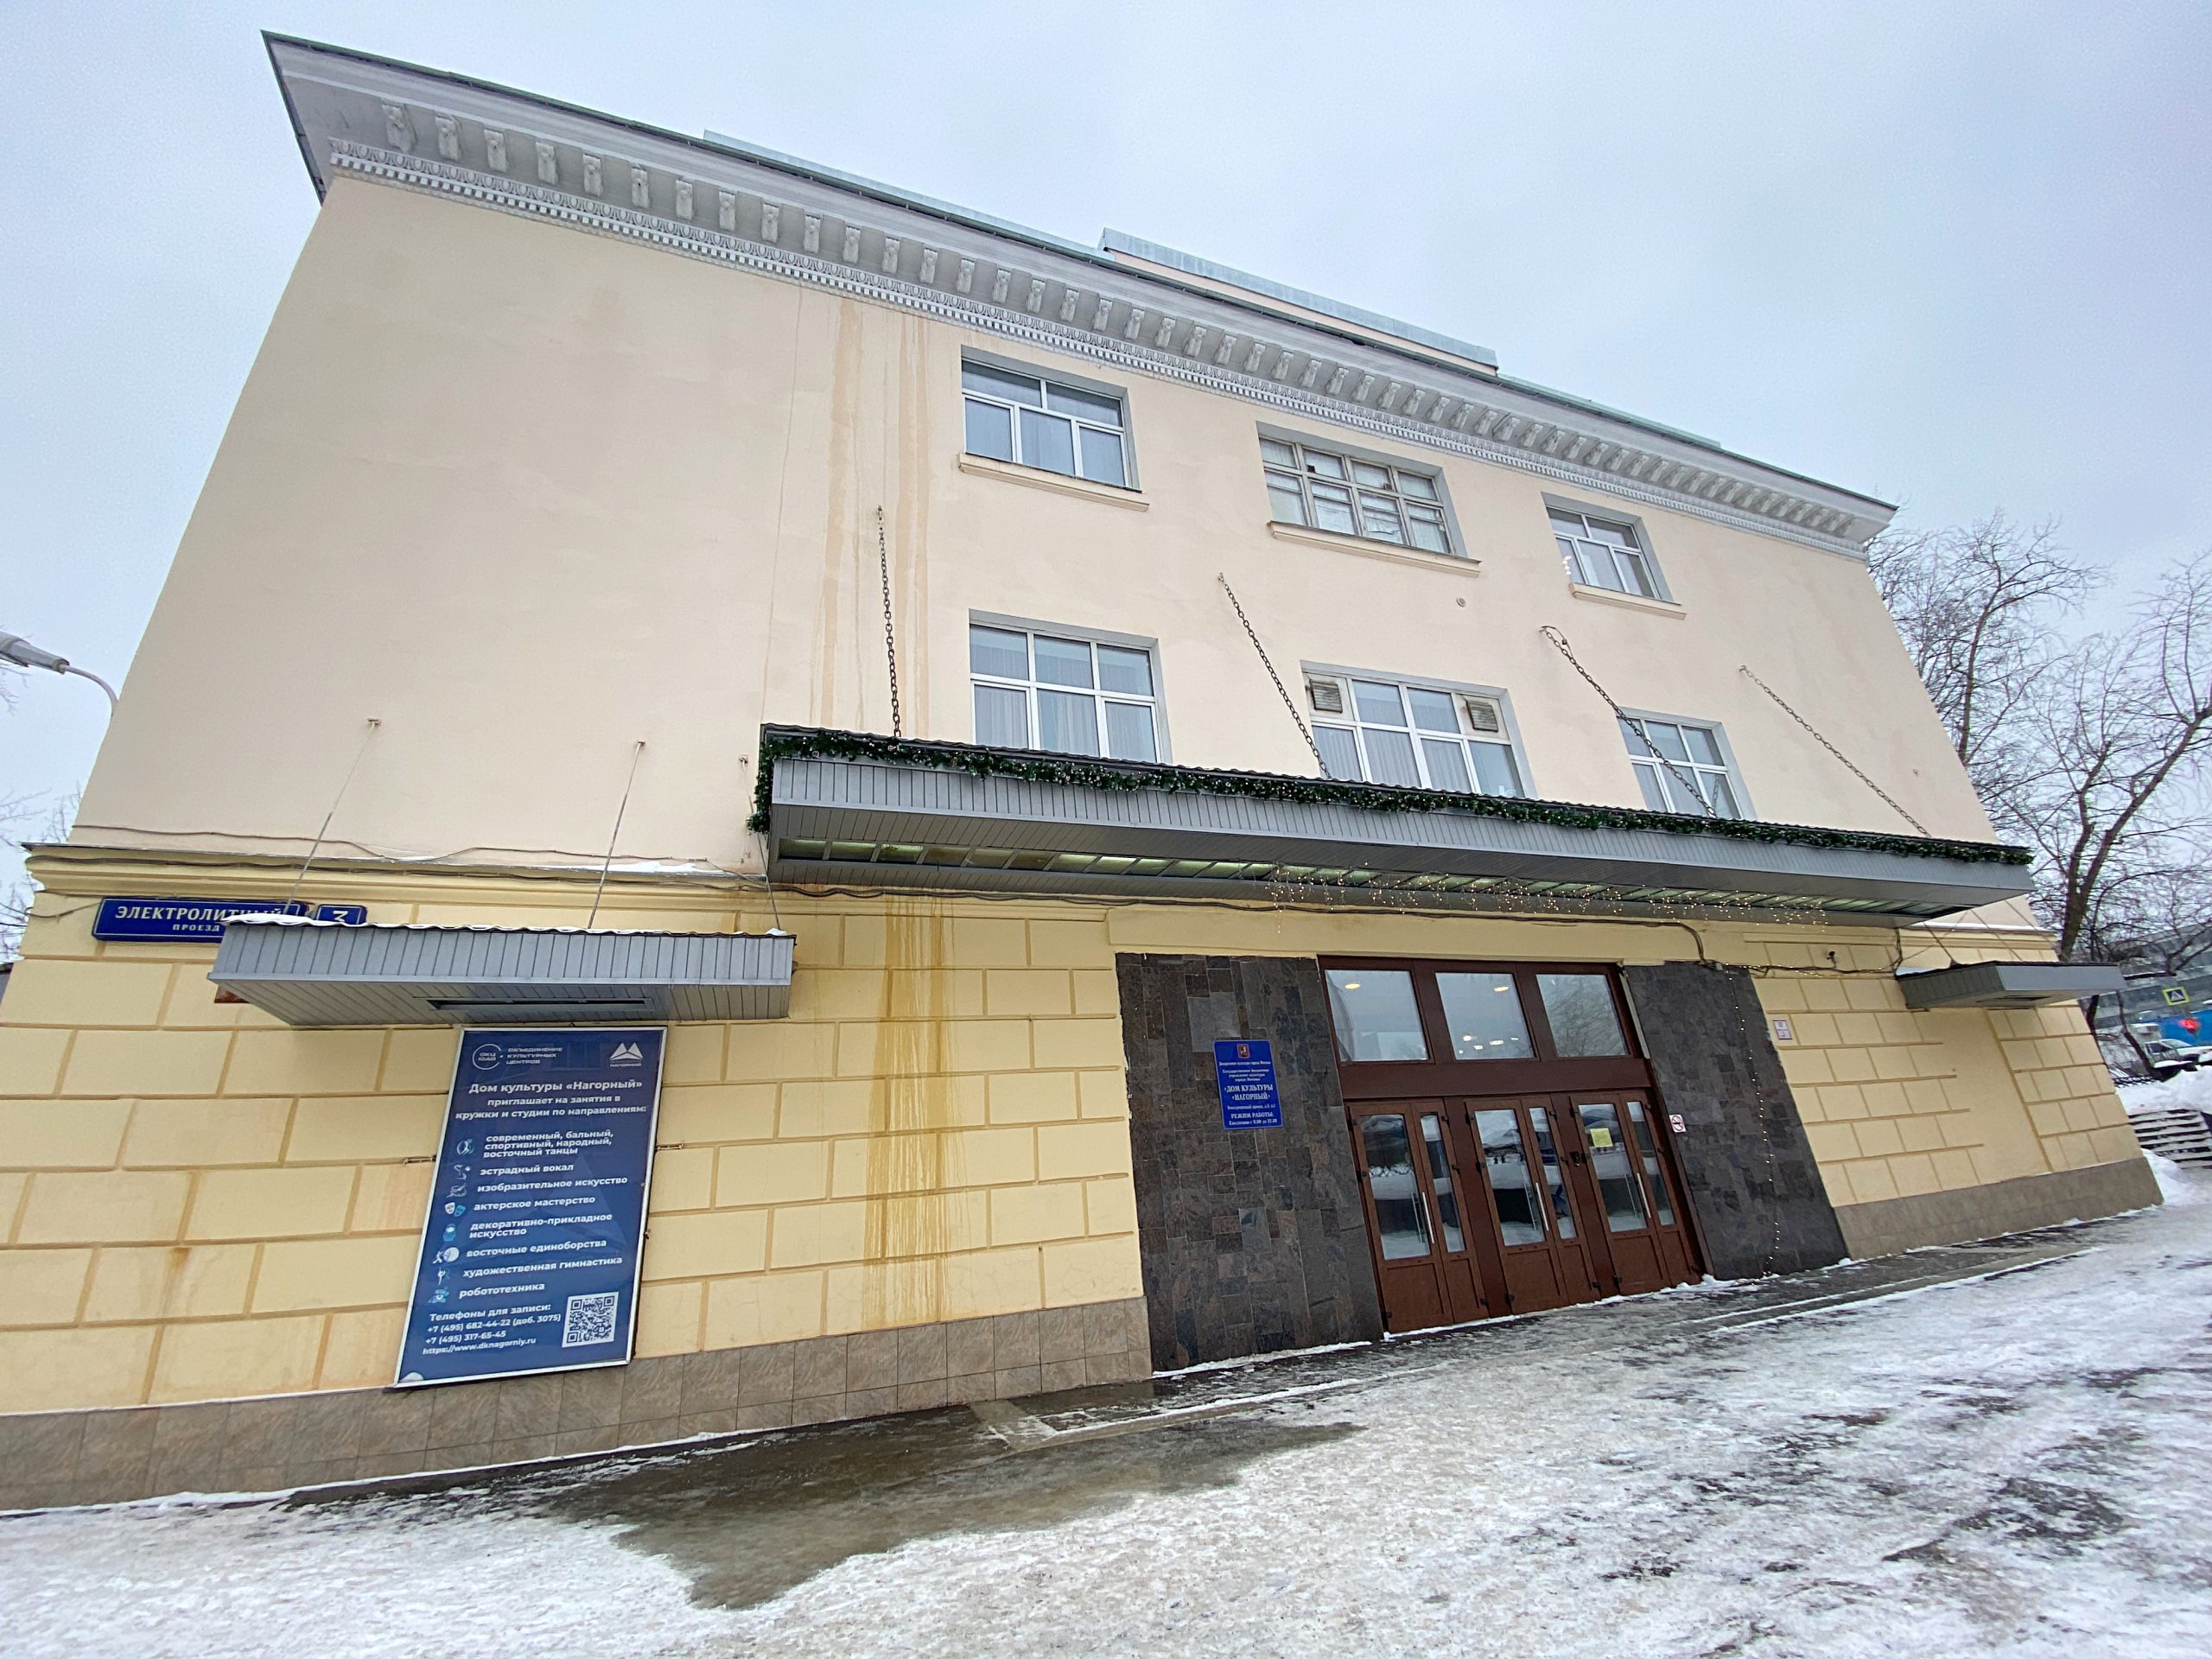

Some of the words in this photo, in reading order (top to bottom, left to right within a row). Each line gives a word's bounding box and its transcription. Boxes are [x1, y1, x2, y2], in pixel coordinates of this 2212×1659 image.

[115, 906, 283, 921] ЭЛЕКТРОЛИТ
[173, 923, 219, 932] ПРОЕЗД
[468, 1084, 498, 1094] Дом
[500, 1082, 563, 1094] культуры
[566, 1079, 643, 1090] «Нагорный»
[487, 1097, 553, 1108] приглашает
[569, 1095, 613, 1103] занятия
[455, 1111, 499, 1121] кружки
[512, 1110, 550, 1119] студии
[568, 1105, 647, 1116] направлениям:
[486, 1131, 563, 1142] современный,
[565, 1129, 613, 1139] бальный,
[484, 1140, 554, 1151] спортивный,
[556, 1137, 612, 1147] народный,
[483, 1147, 543, 1158] восточный
[545, 1147, 578, 1156] танцы
[480, 1165, 540, 1176] эстрадный
[543, 1164, 574, 1173] вокал
[477, 1180, 572, 1192] изобразительное
[575, 1177, 628, 1187] искусство
[474, 1200, 531, 1211] актерское
[534, 1197, 595, 1208] мастерство
[470, 1213, 613, 1230] декоративно-прикладное
[469, 1228, 527, 1239] искусство
[467, 1247, 527, 1257] восточные
[530, 1240, 607, 1253] единоборства
[463, 1263, 556, 1278] художественная
[559, 1257, 622, 1269] гимнастика
[459, 1283, 545, 1299] робототехника
[429, 1310, 486, 1322] Телефоны
[488, 1307, 508, 1317] для
[510, 1304, 551, 1314] записи:
[441, 1324, 464, 1333] (495)
[513, 1317, 535, 1327] (доб.
[537, 1313, 562, 1324] 3075)
[438, 1335, 461, 1344] (495)
[464, 1331, 506, 1341] 317-65-45
[423, 1338, 537, 1355] https://www.dknagorniy.ru
